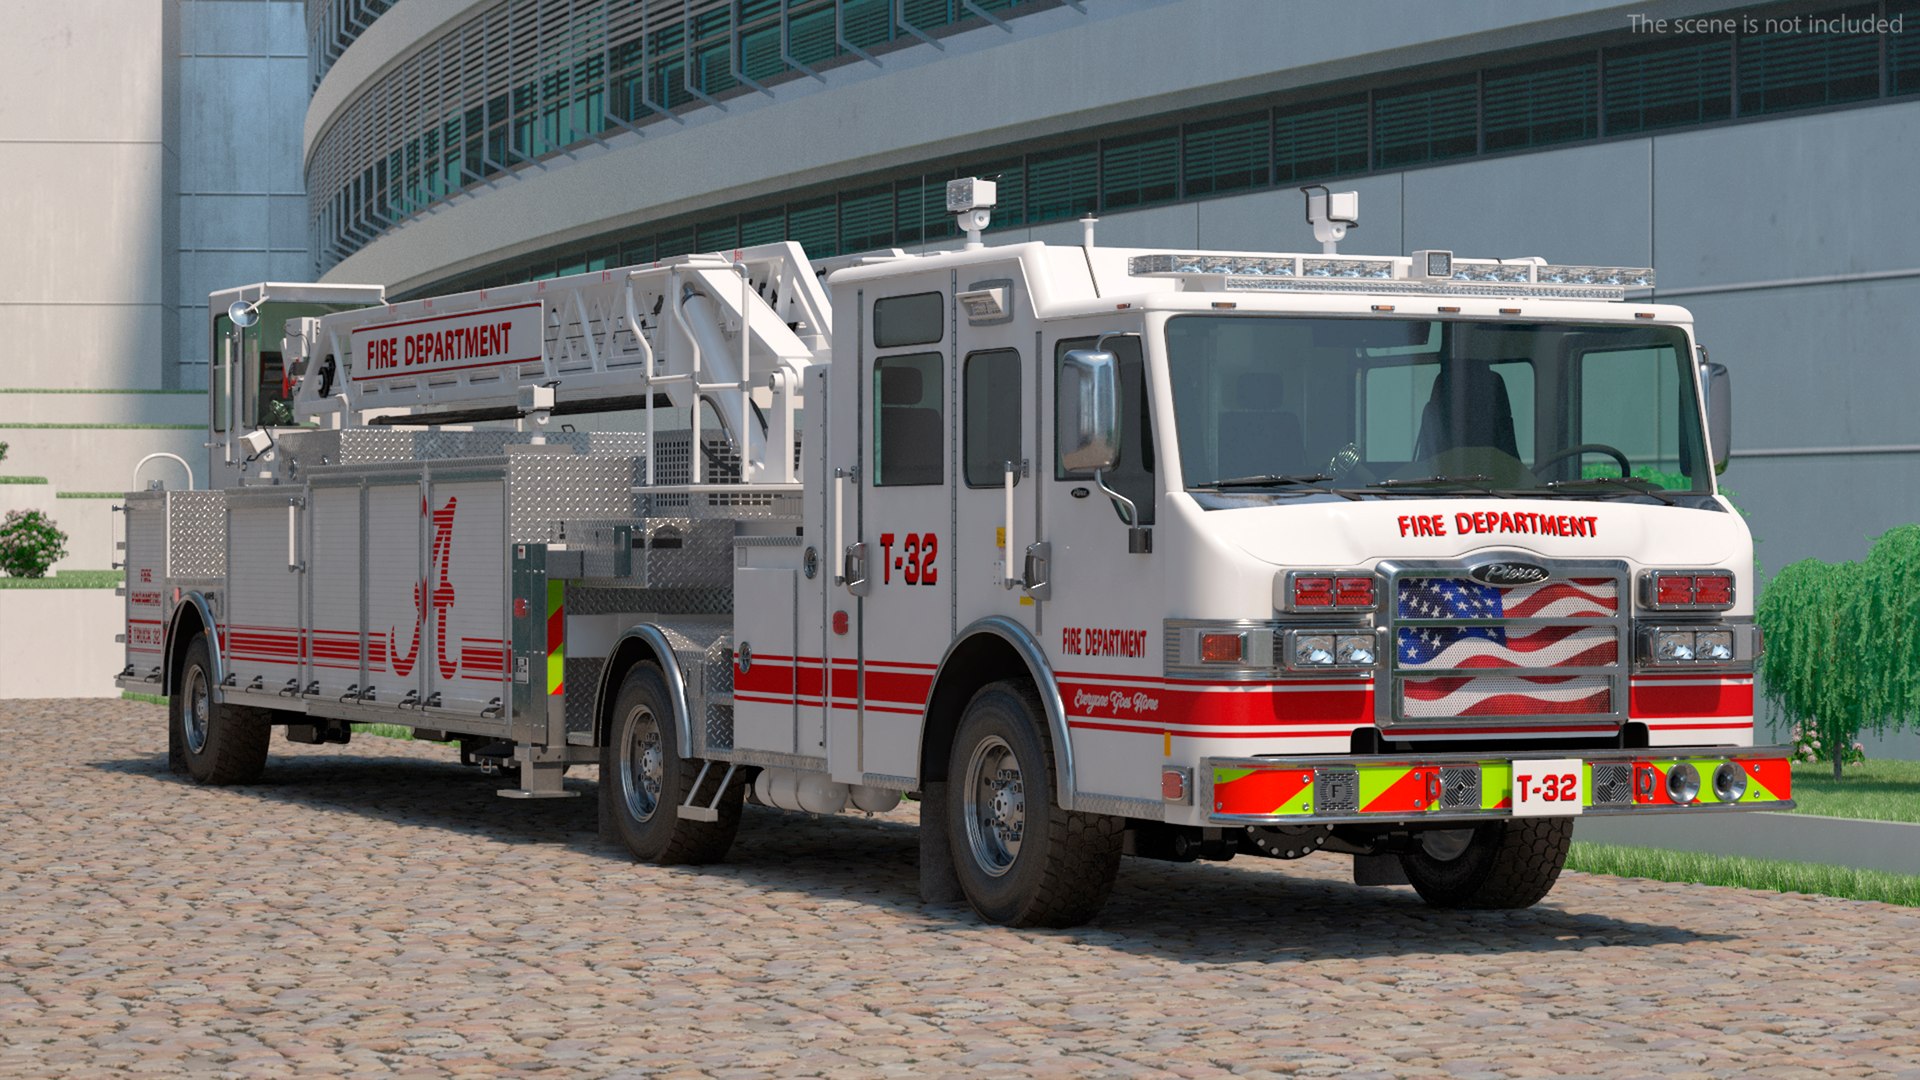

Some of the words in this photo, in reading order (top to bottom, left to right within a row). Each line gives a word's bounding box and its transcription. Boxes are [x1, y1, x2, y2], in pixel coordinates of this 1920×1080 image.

[367, 337, 398, 370] FIRE
[404, 321, 512, 366] DEPARTMENT
[1397, 514, 1447, 538] FIRE
[1455, 511, 1599, 538] DEPARTMENT
[880, 533, 938, 586] T-32
[1484, 563, 1543, 582] Pierce
[1063, 627, 1082, 656] FIRE
[1085, 628, 1147, 658] DEPARTMENT
[1074, 688, 1109, 714] Everyone
[1109, 690, 1132, 715] Goes
[1132, 692, 1159, 713] Home
[1516, 774, 1577, 803] T-32
